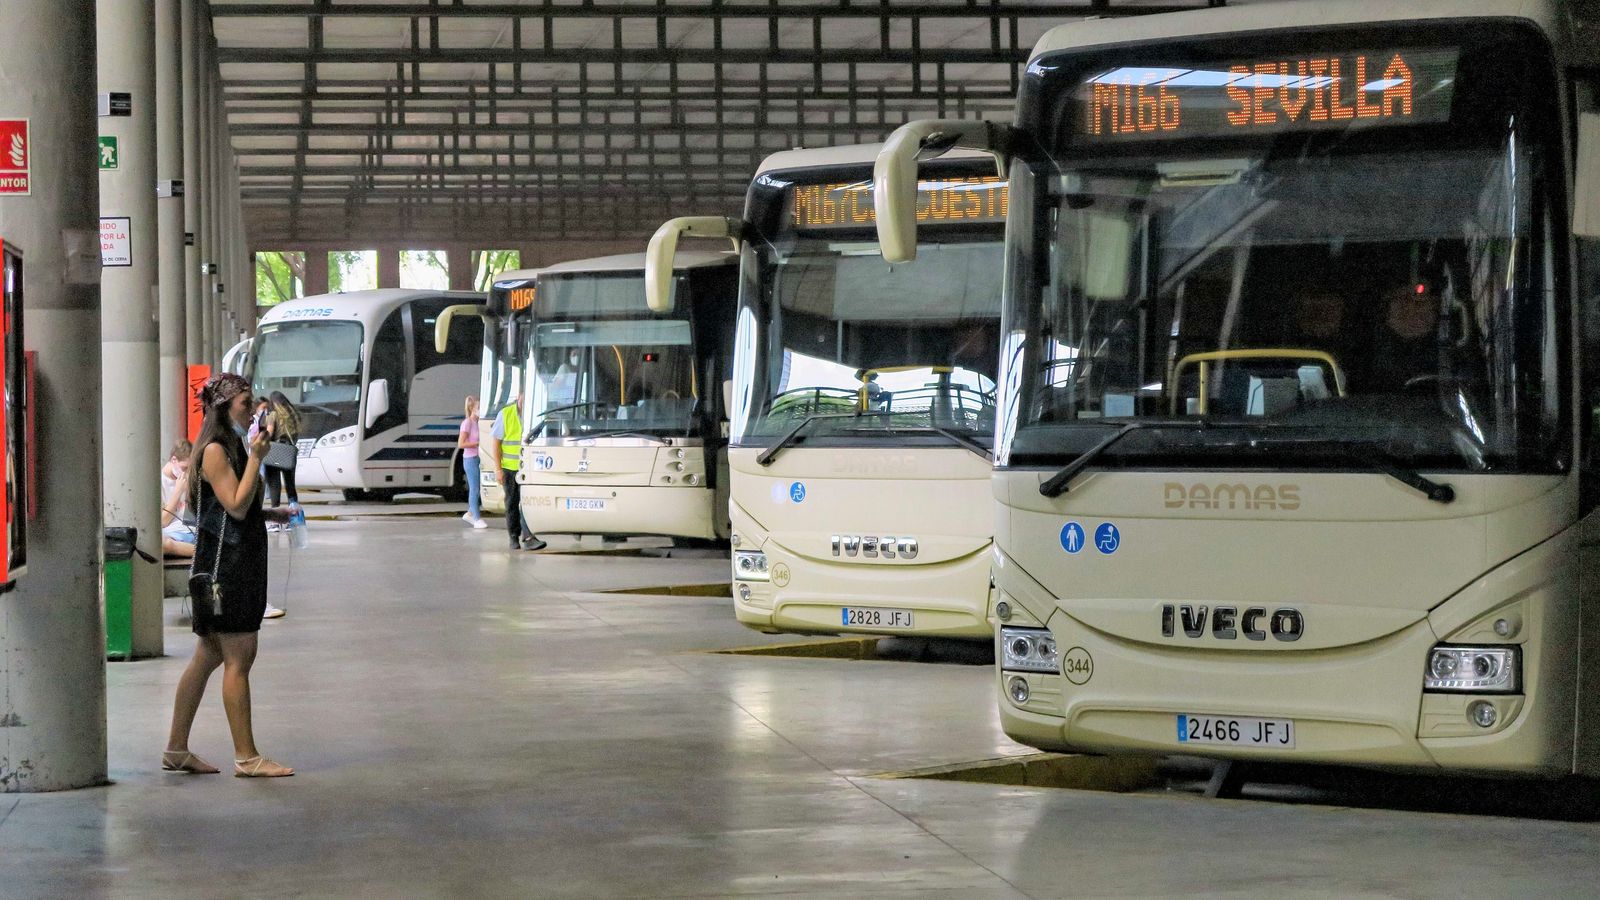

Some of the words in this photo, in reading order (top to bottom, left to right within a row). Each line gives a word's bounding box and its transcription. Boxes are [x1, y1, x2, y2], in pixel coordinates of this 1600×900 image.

[1091, 71, 1180, 134] M166
[1226, 54, 1413, 126] SEVILLA
[0, 177, 27, 188] NTOR
[281, 308, 334, 319] DAMAS
[1164, 482, 1301, 511] DAMAS
[831, 535, 919, 560] IVECO
[774, 569, 788, 580] 346
[849, 610, 881, 625] 2828
[887, 611, 911, 627] JFJ
[1161, 604, 1305, 642] IVECO
[1067, 658, 1090, 673] 344
[1189, 718, 1240, 741] 2466
[1252, 721, 1289, 744] JFJ
